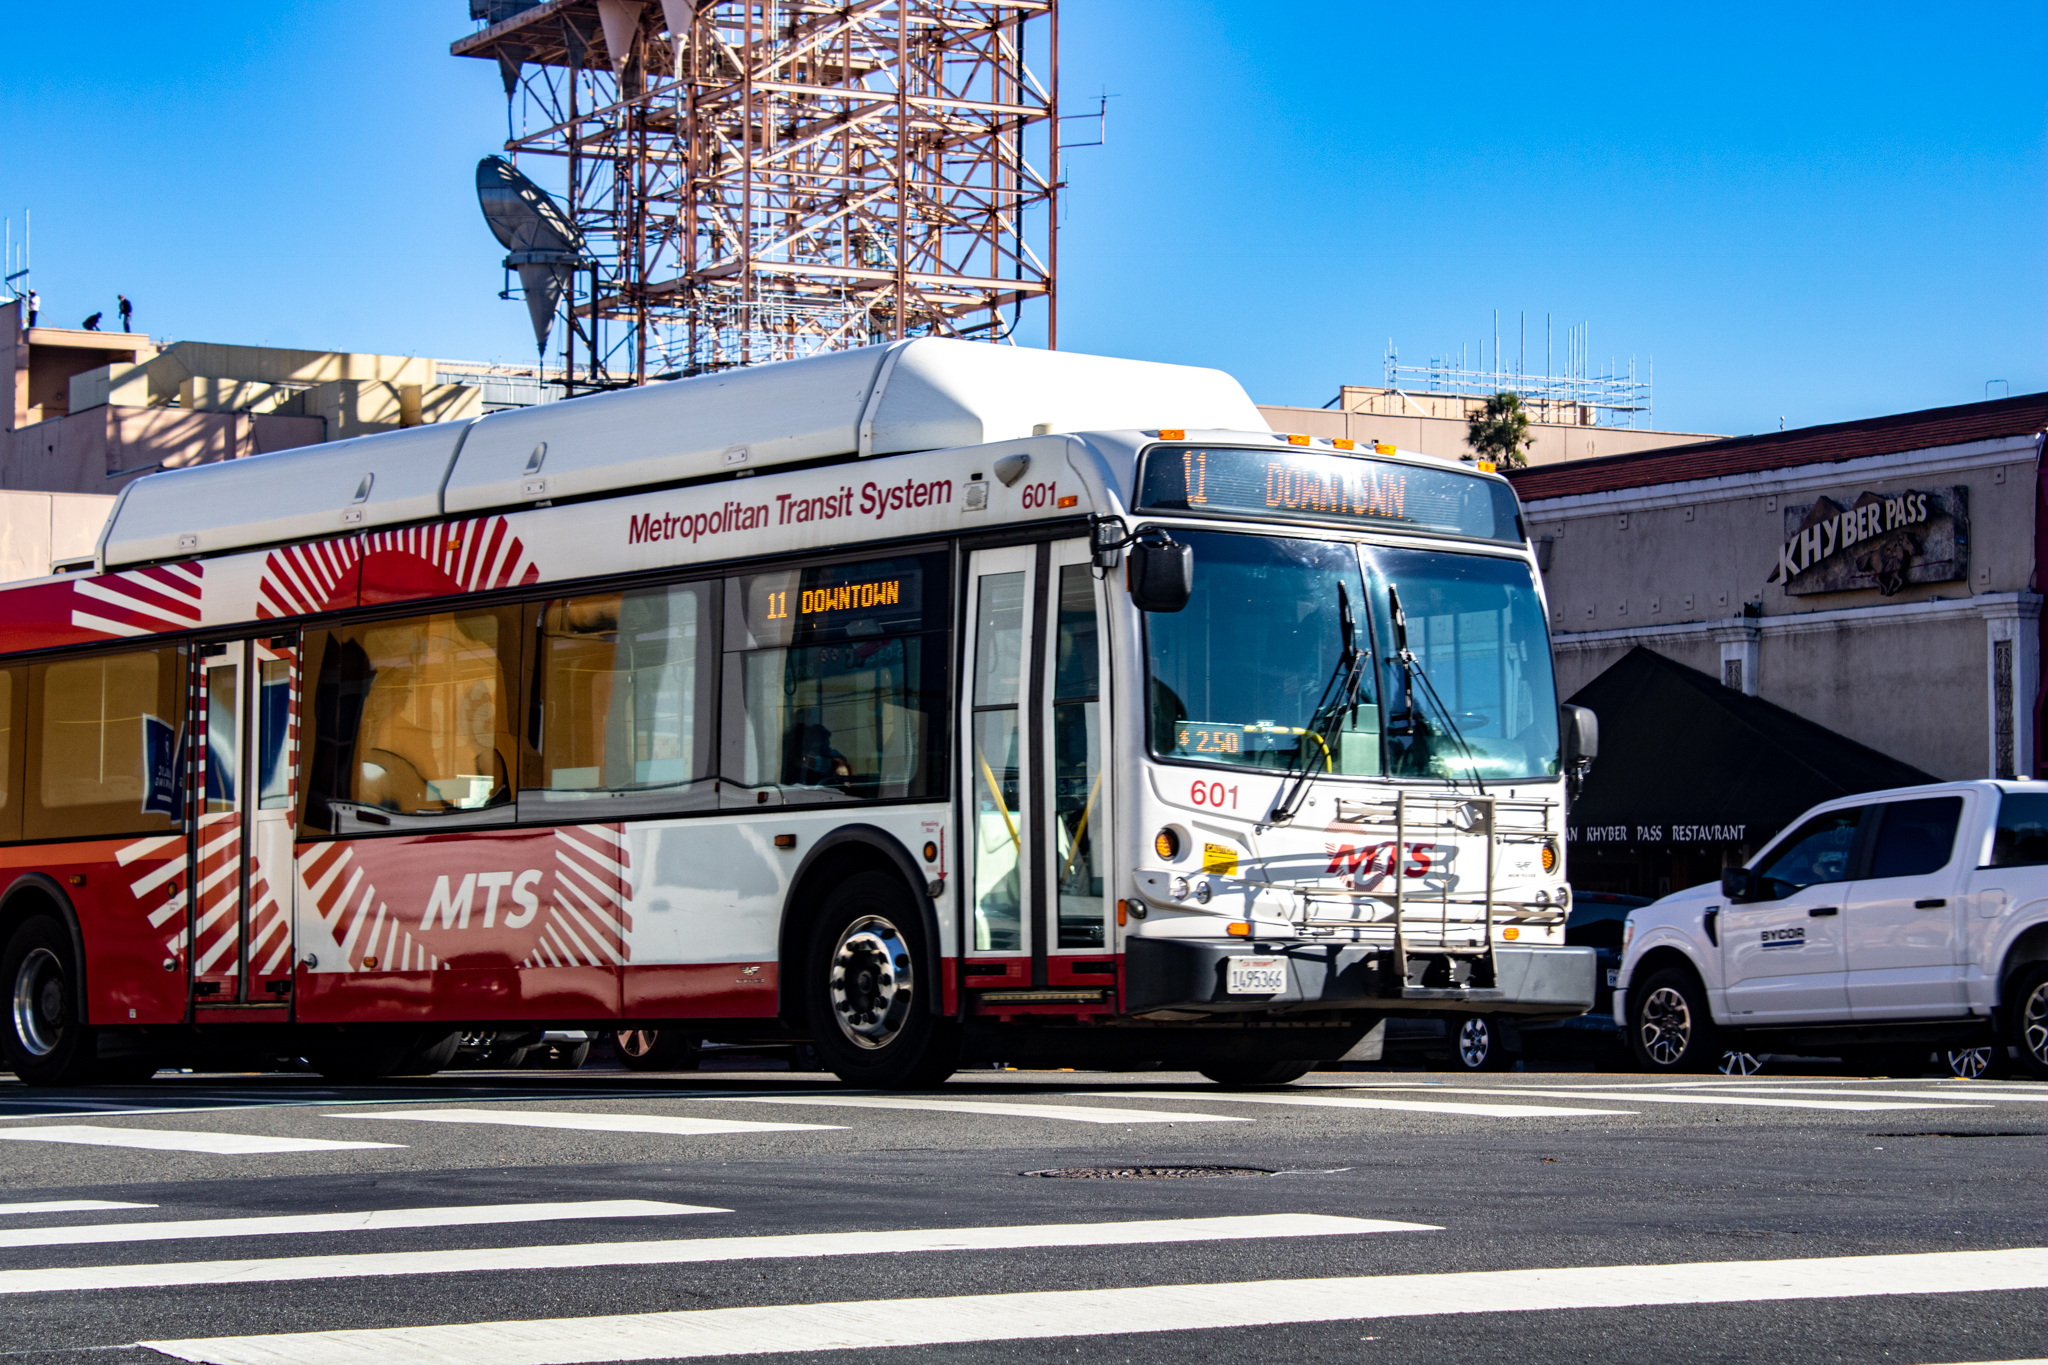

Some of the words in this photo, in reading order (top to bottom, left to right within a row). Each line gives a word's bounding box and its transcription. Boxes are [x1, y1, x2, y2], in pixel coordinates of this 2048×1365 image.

[1022, 481, 1057, 510] 601
[1182, 450, 1207, 503] 11
[1265, 462, 1406, 518] DOWNTOWN
[628, 501, 769, 545] Metropolitan
[775, 486, 853, 526] Transit
[859, 478, 953, 520] System
[1779, 502, 1883, 586] KHYBER
[1885, 493, 1927, 531] PASS
[767, 591, 788, 620] 11
[801, 580, 899, 614] DOWNTOWN
[1178, 729, 1190, 746] $
[1195, 730, 1239, 753] 2.50
[1190, 779, 1239, 810] 601
[1586, 825, 1628, 842] KHYBER
[1636, 825, 1663, 842] PASS
[1671, 824, 1746, 842] RESTAURANT
[1325, 841, 1437, 878] MTS
[418, 868, 544, 931] MTS
[1760, 927, 1805, 941] BYCOR
[1232, 970, 1283, 988] 1495366
